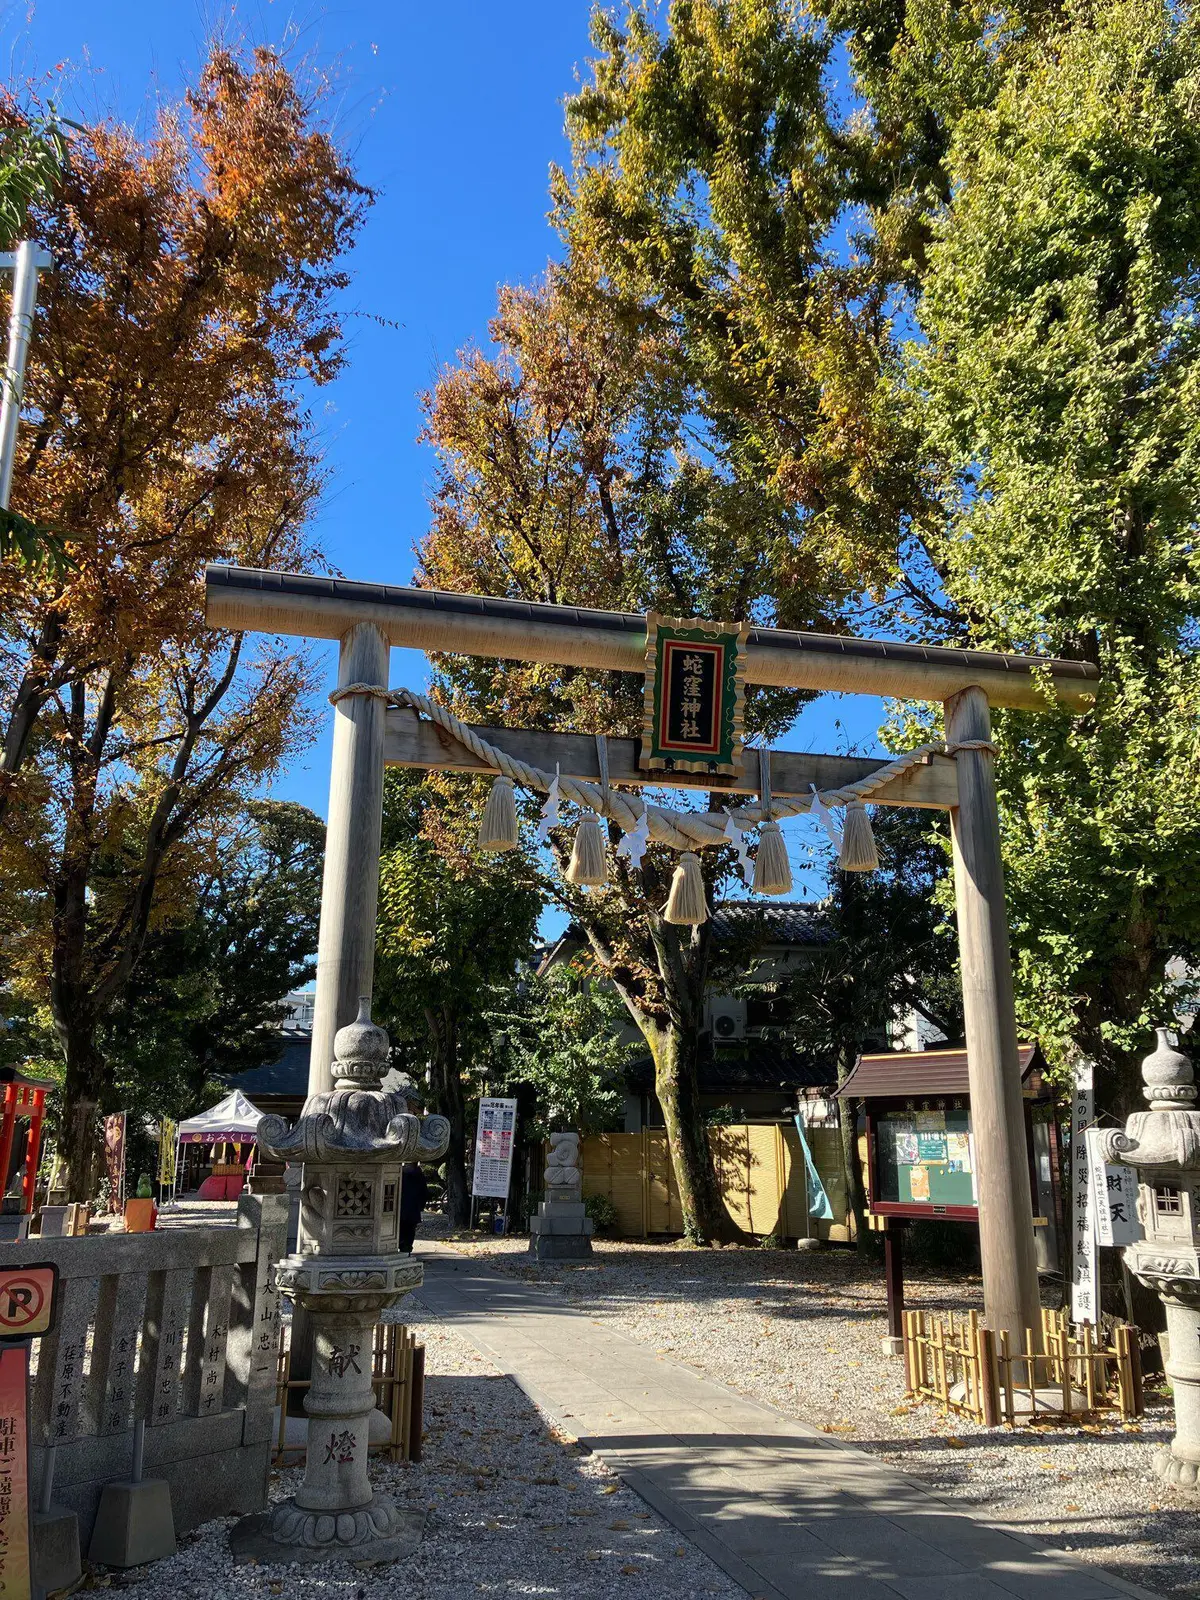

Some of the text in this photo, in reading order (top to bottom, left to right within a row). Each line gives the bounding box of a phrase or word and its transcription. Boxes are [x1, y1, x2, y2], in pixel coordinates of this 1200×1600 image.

[680, 654, 704, 739] 蛇窪神社
[54, 1344, 77, 1438] 荏原不動産
[204, 1324, 221, 1408] 木村尚子
